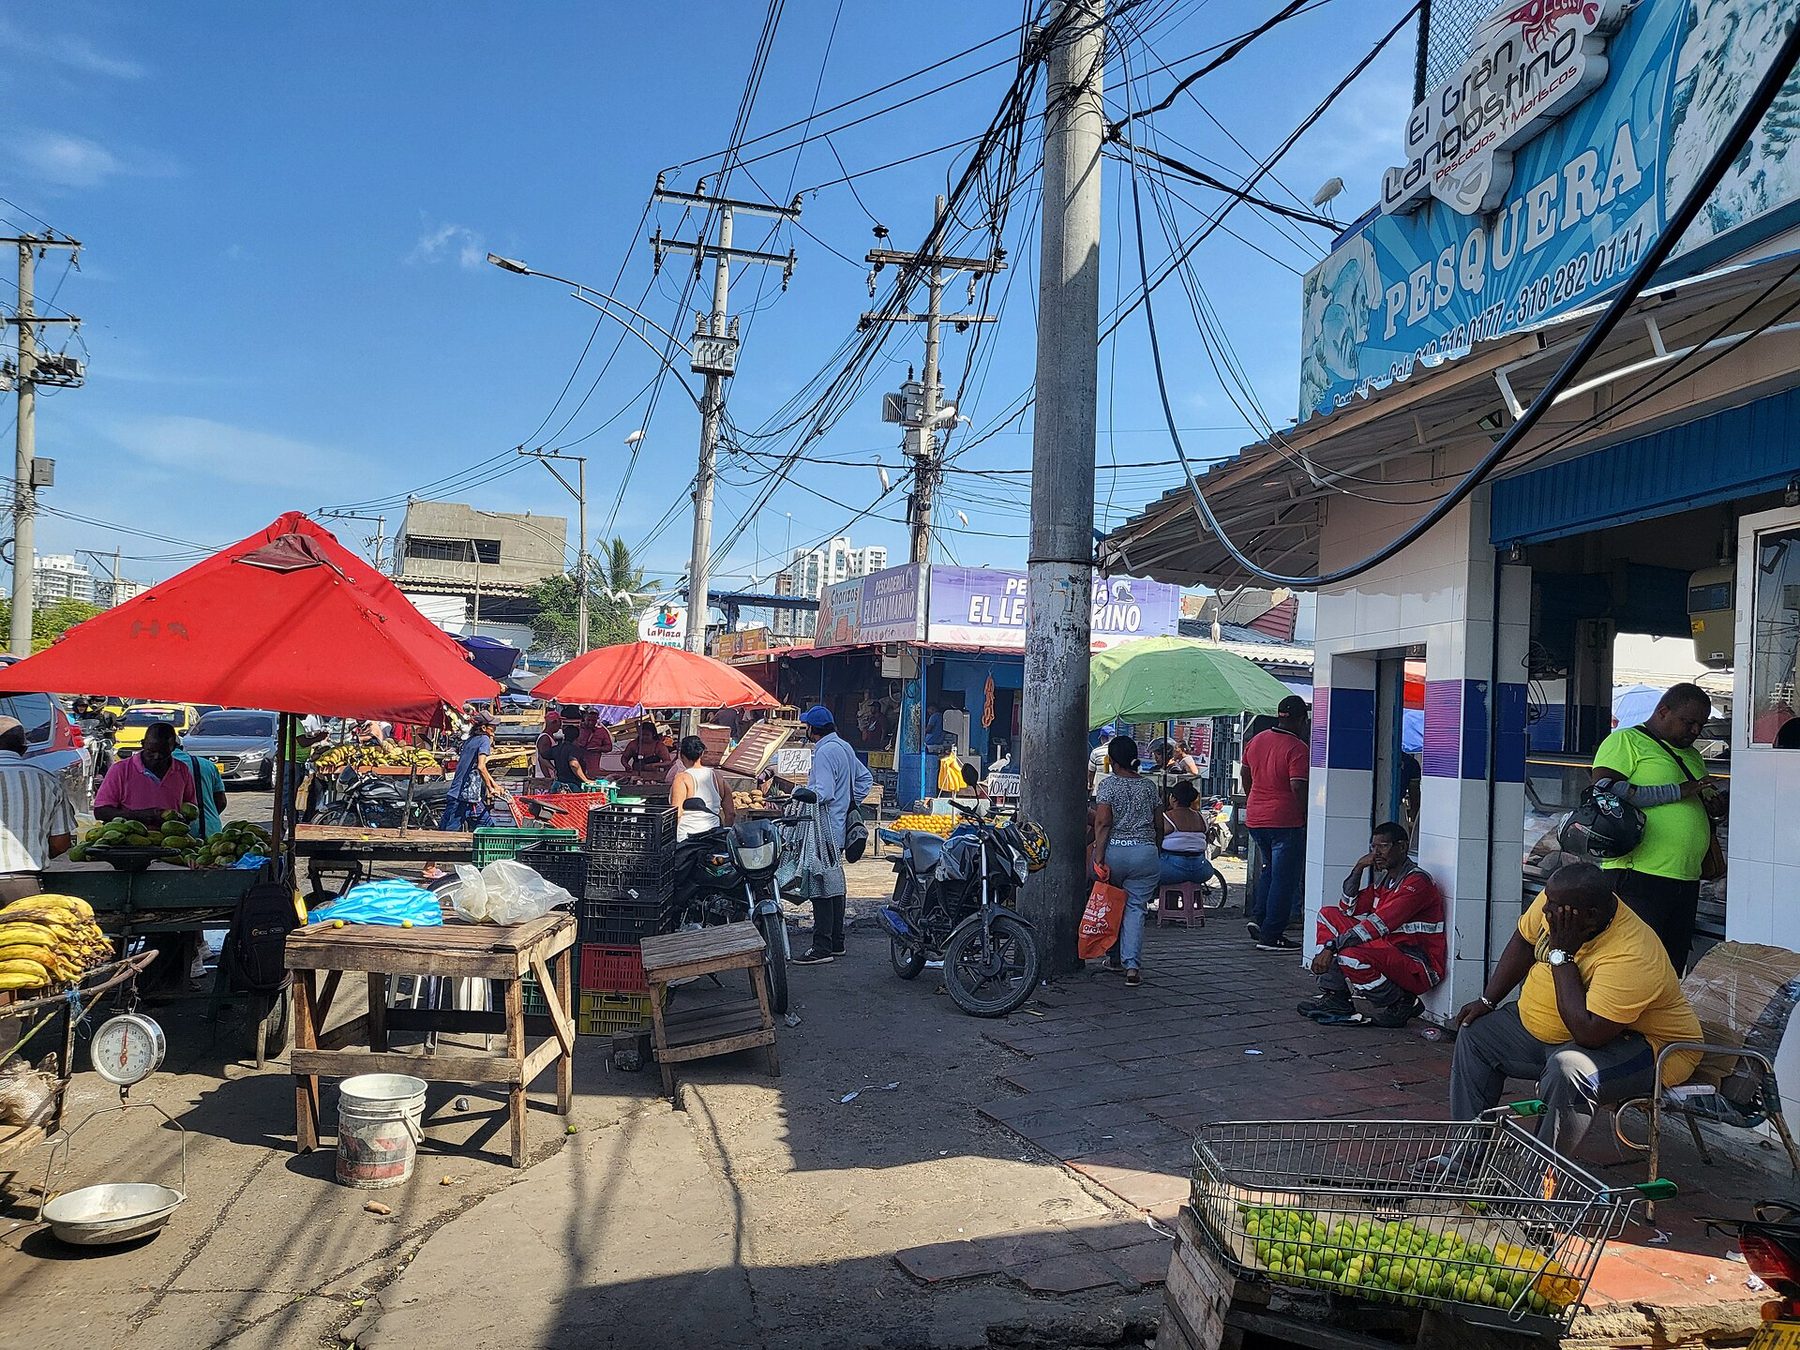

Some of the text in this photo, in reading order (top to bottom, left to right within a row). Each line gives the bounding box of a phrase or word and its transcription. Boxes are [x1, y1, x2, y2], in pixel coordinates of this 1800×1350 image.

[1386, 27, 1576, 204] Langostino
[1409, 40, 1513, 146] El Gran
[1384, 122, 1642, 341] PESQUERA
[1467, 303, 1504, 346] 0177
[1517, 275, 1550, 324] 318
[1553, 253, 1589, 305] 282
[1593, 222, 1644, 286] 0111
[647, 628, 657, 637] La
[967, 594, 1141, 633] EL LE RINO
